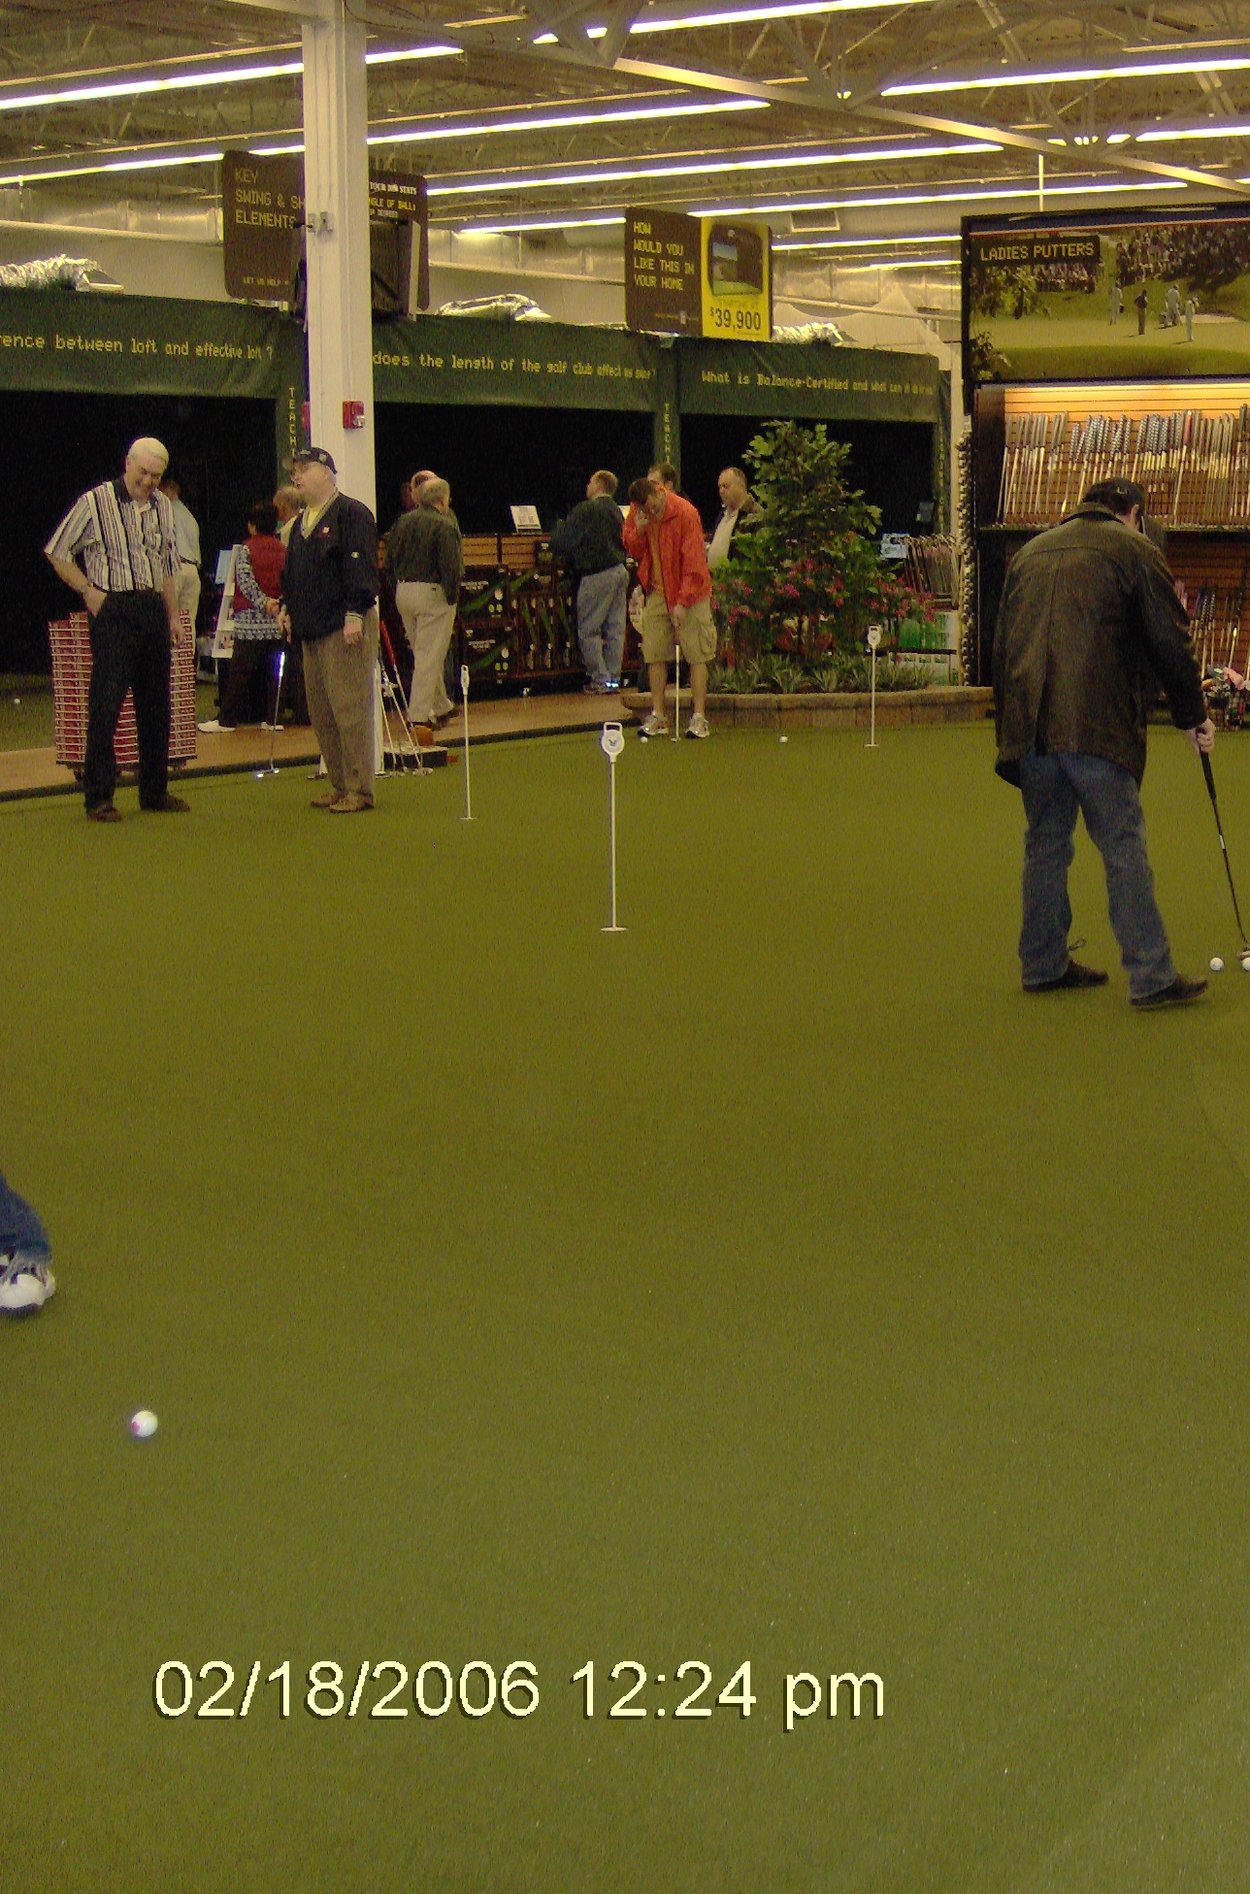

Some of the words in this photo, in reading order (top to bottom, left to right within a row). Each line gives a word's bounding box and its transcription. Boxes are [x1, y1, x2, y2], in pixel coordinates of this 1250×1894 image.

[235, 168, 259, 184] KEY
[235, 190, 272, 206] SWING
[276, 193, 286, 208] &
[235, 209, 297, 230] ELEMENTS
[633, 221, 652, 235] HOW
[633, 239, 662, 254] WOULD
[666, 243, 684, 256] YOU
[980, 245, 1029, 261] LADIES
[1033, 242, 1095, 258] PUTTERS
[634, 257, 655, 271] LIKE
[659, 259, 680, 273] THIS
[684, 262, 695, 275] IN
[633, 274, 657, 288] YOUR
[661, 277, 683, 291] HOME
[710, 306, 761, 332] $39,900
[0, 333, 46, 349] ence
[55, 333, 123, 353] between
[131, 338, 158, 355] loft
[165, 341, 189, 357] and
[195, 344, 243, 360] effective
[372, 351, 411, 366] does
[418, 352, 444, 369] the
[451, 354, 494, 371] length
[500, 358, 514, 371] of
[521, 358, 541, 373] the
[701, 370, 730, 384] What
[737, 372, 750, 385] is
